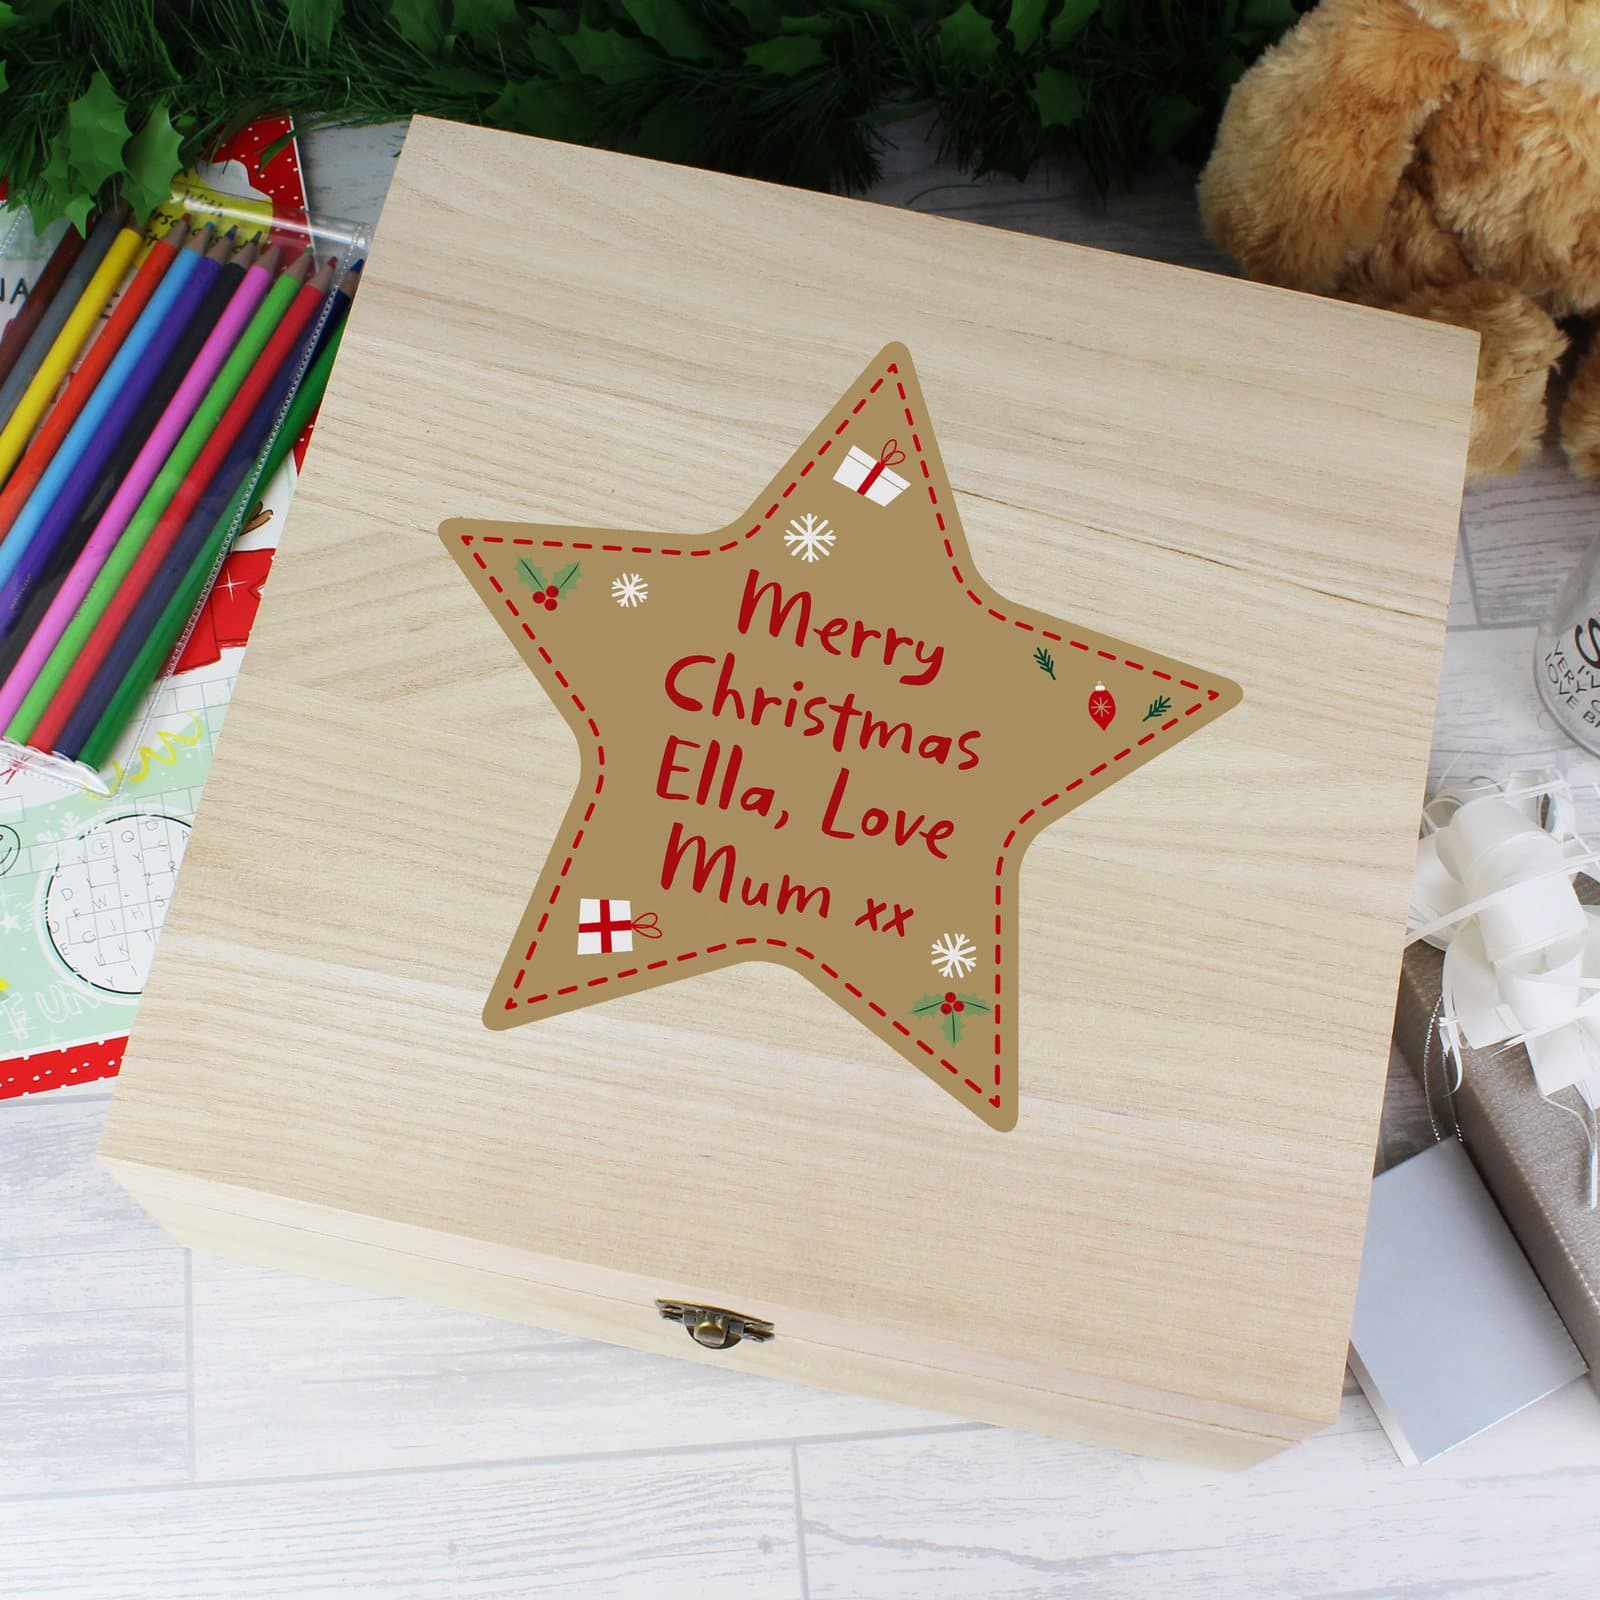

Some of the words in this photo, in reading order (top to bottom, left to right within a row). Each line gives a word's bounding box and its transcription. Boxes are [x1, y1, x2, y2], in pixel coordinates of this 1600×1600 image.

[737, 568, 945, 687] Merry
[664, 651, 982, 771] Christmas
[655, 735, 790, 830] Ella,
[821, 767, 955, 860] Love
[660, 820, 831, 919] Mum
[853, 897, 915, 938] xx
